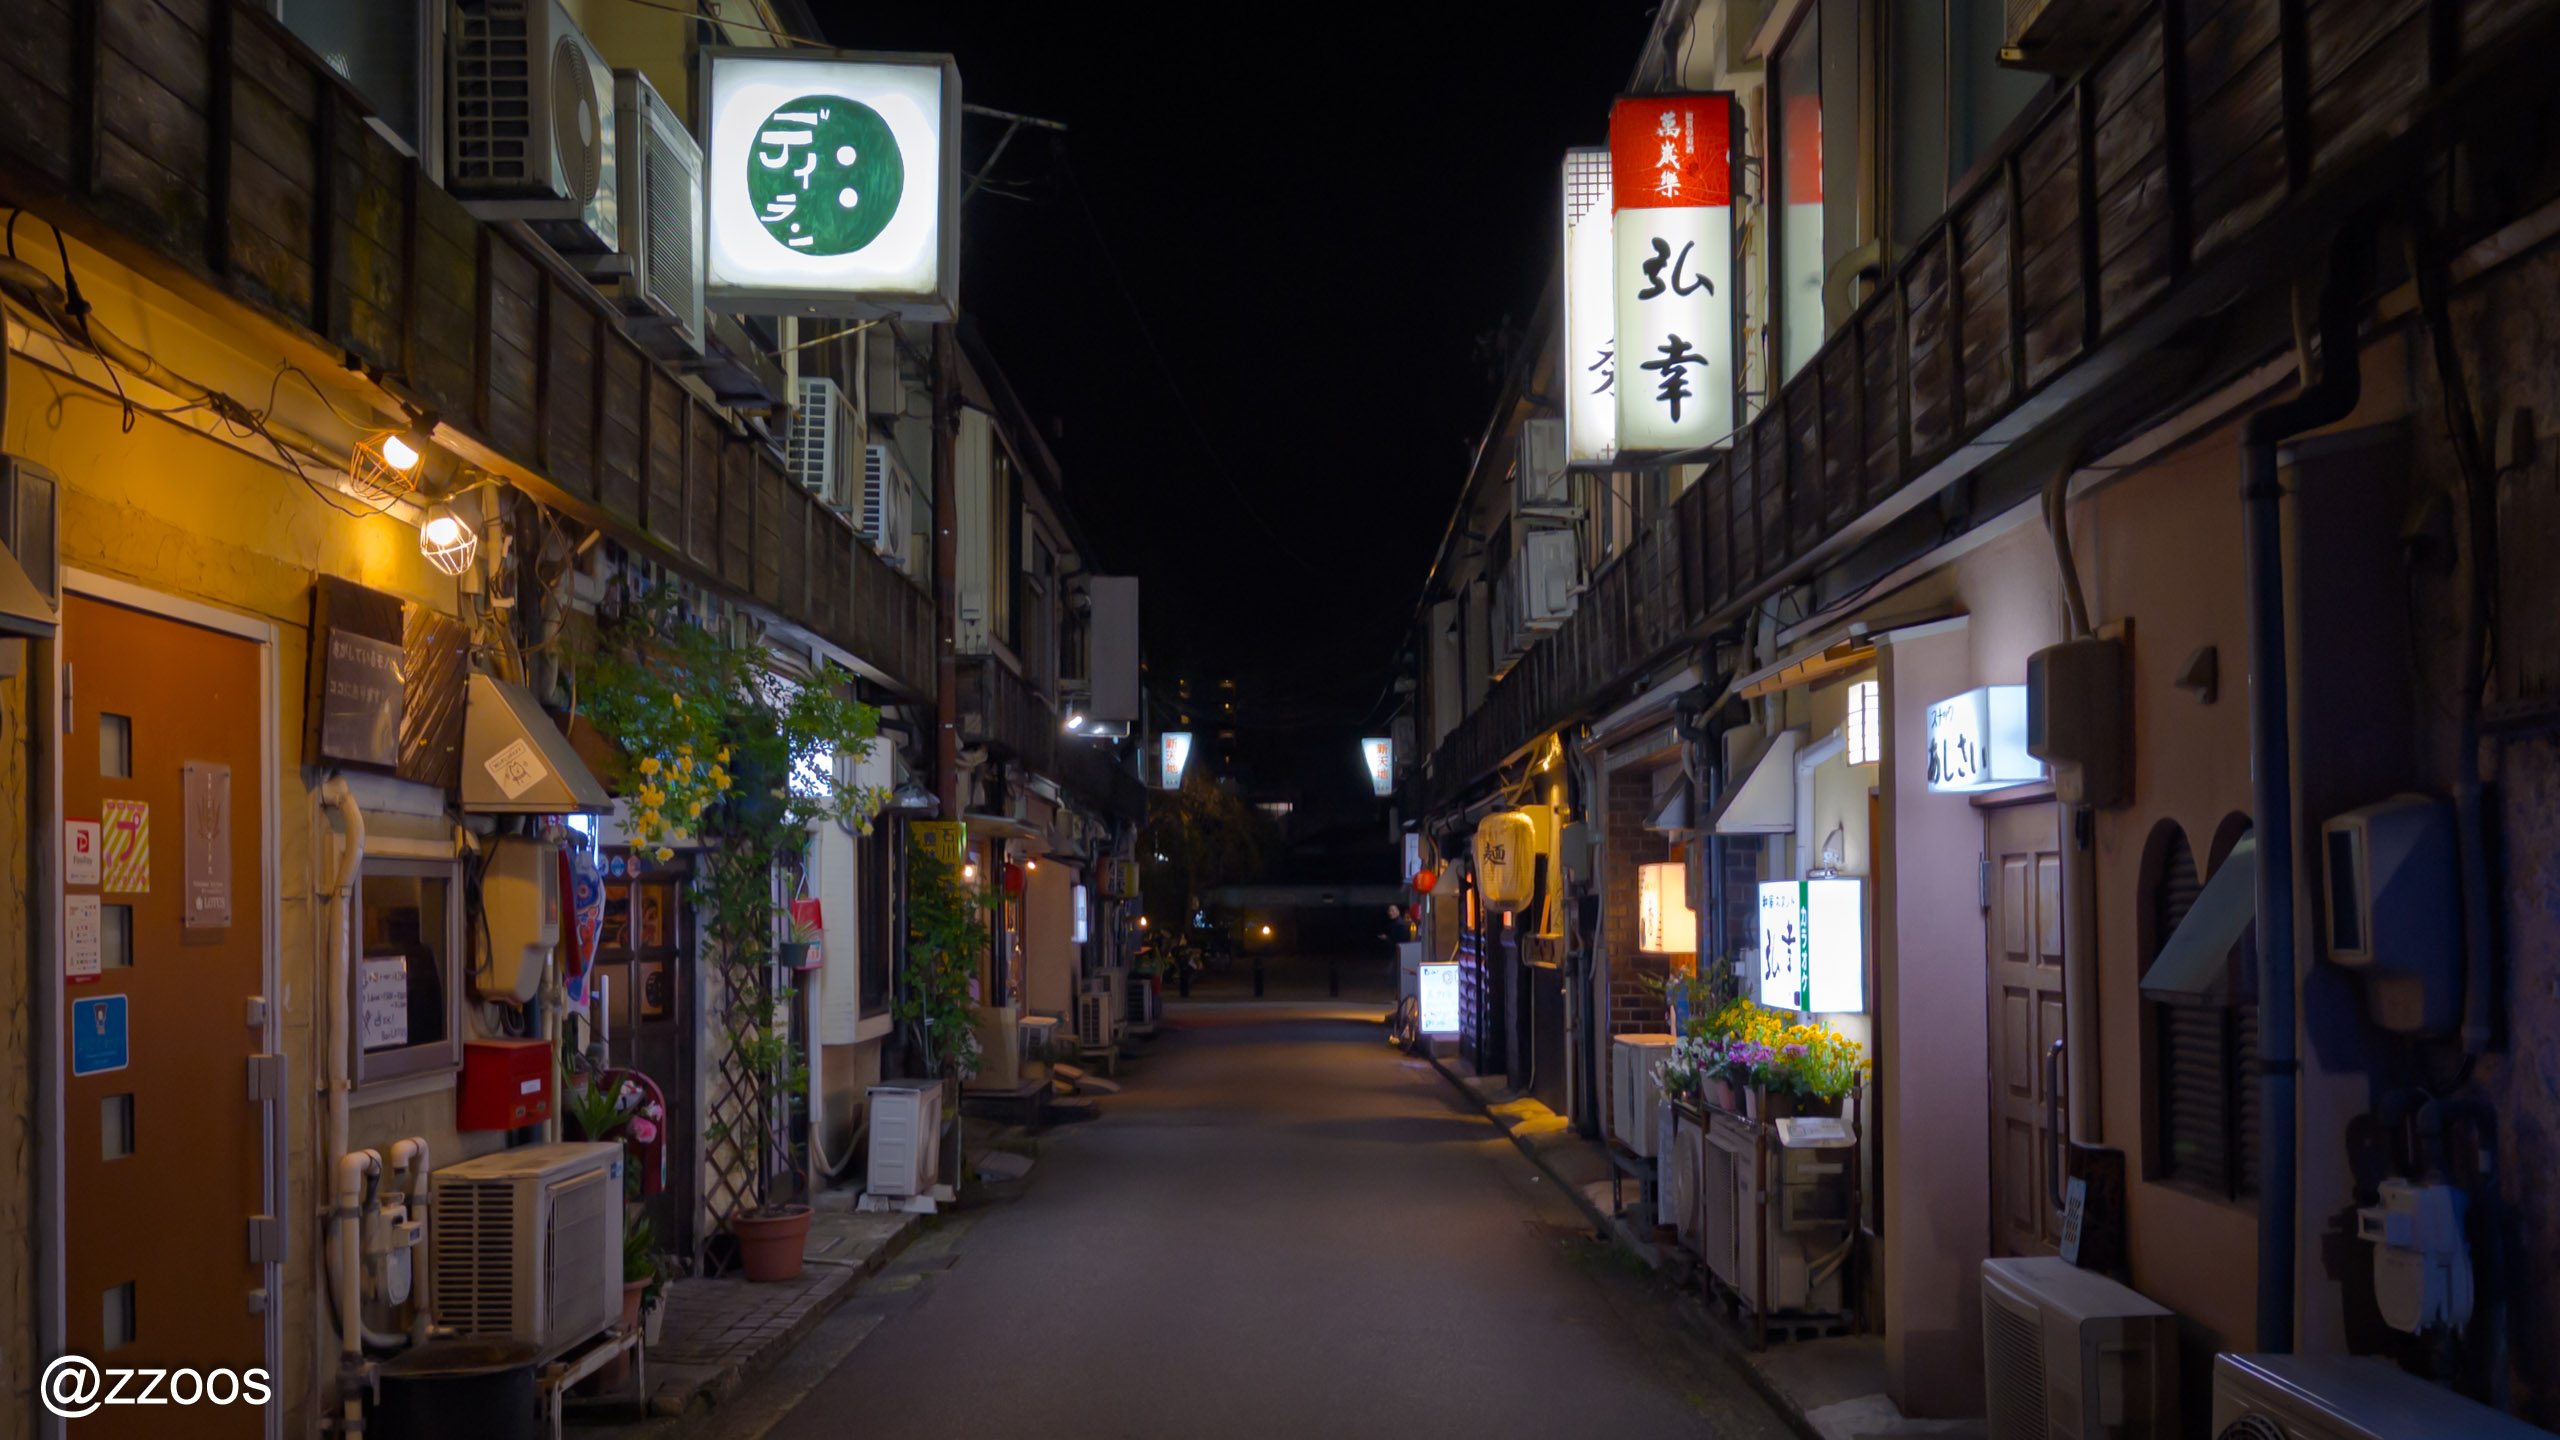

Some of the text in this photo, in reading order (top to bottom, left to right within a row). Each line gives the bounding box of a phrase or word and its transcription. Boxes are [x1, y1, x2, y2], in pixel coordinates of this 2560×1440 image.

[759, 108, 830, 247] ディラン
[1638, 236, 1715, 425] 弘幸
[1483, 842, 1506, 866] 麺
[1800, 905, 1809, 992] カラオケ
